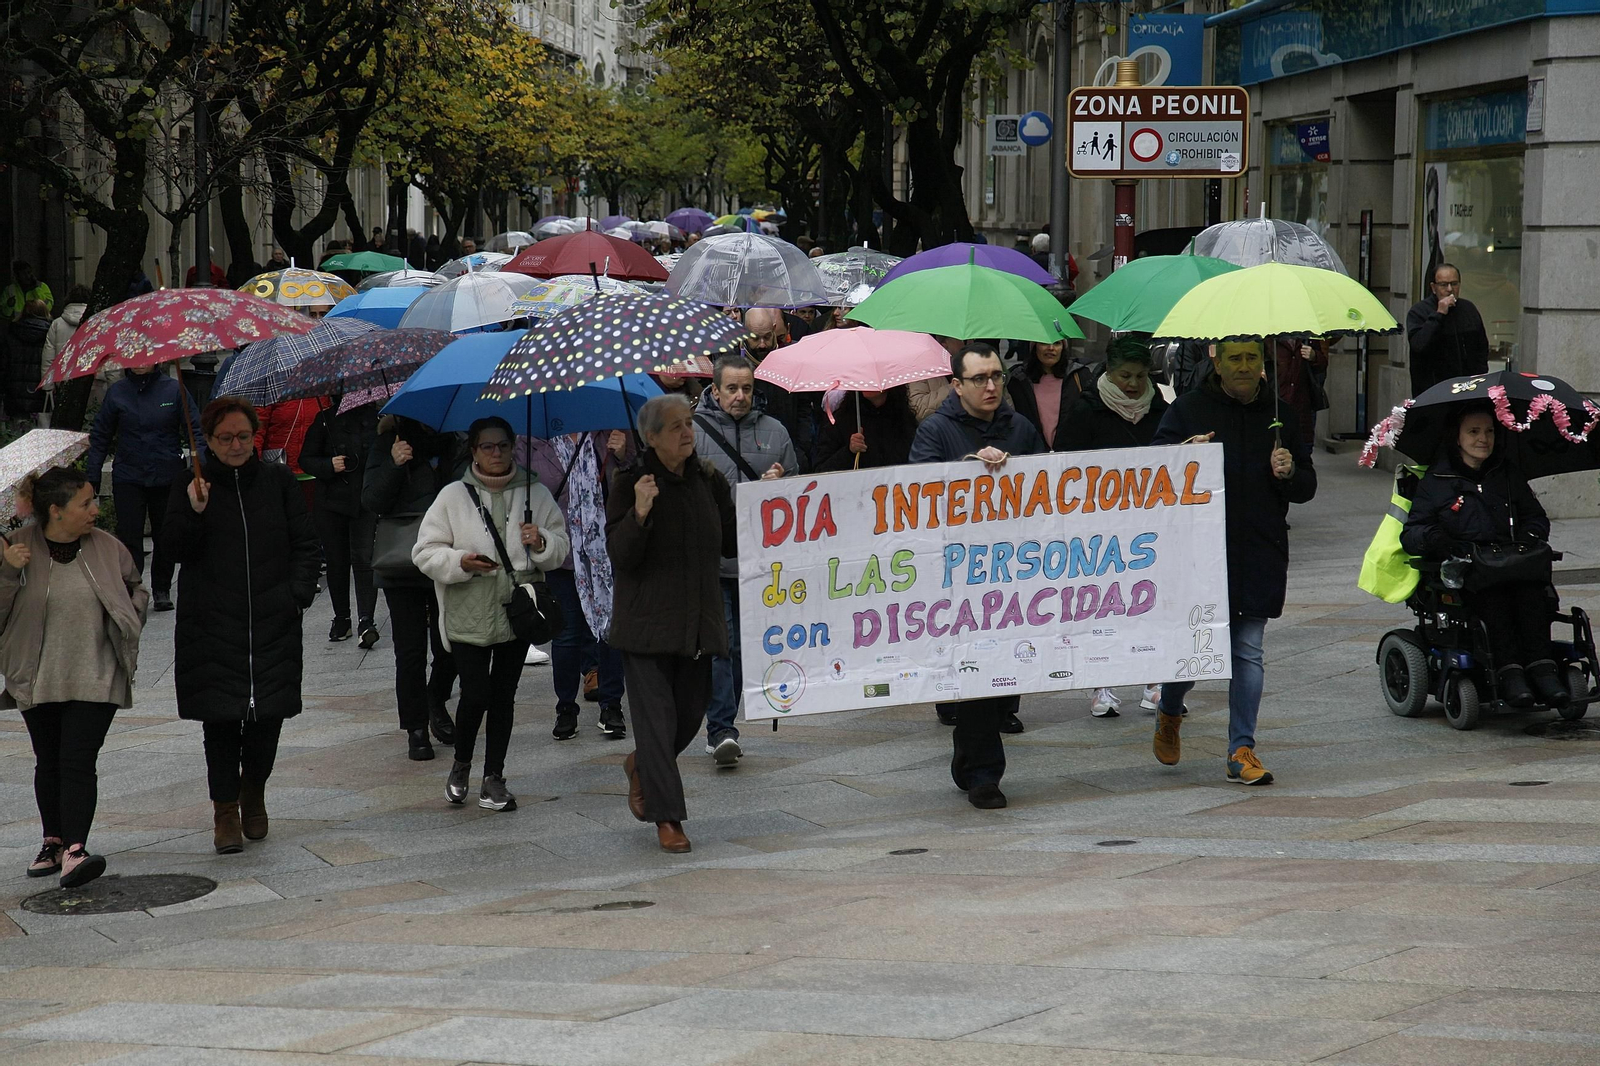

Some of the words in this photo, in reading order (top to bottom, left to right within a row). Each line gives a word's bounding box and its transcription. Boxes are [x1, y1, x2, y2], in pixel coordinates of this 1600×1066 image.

[1074, 95, 1142, 116] ZONA
[1152, 95, 1242, 115] PEONIL
[1168, 130, 1239, 143] CIRCULACIÓN
[1175, 149, 1230, 159] PROHIBID
[761, 480, 838, 549] DÍA
[872, 460, 1212, 535] INTERNACIONAL
[762, 562, 807, 608] de
[828, 549, 918, 600] LAS
[942, 532, 1159, 589] PERSONAS
[762, 622, 831, 656] con
[853, 579, 1158, 649] DISCAPACIDAD
[1188, 603, 1218, 631] 03
[1192, 628, 1214, 654] 12
[1174, 654, 1226, 680] 2025
